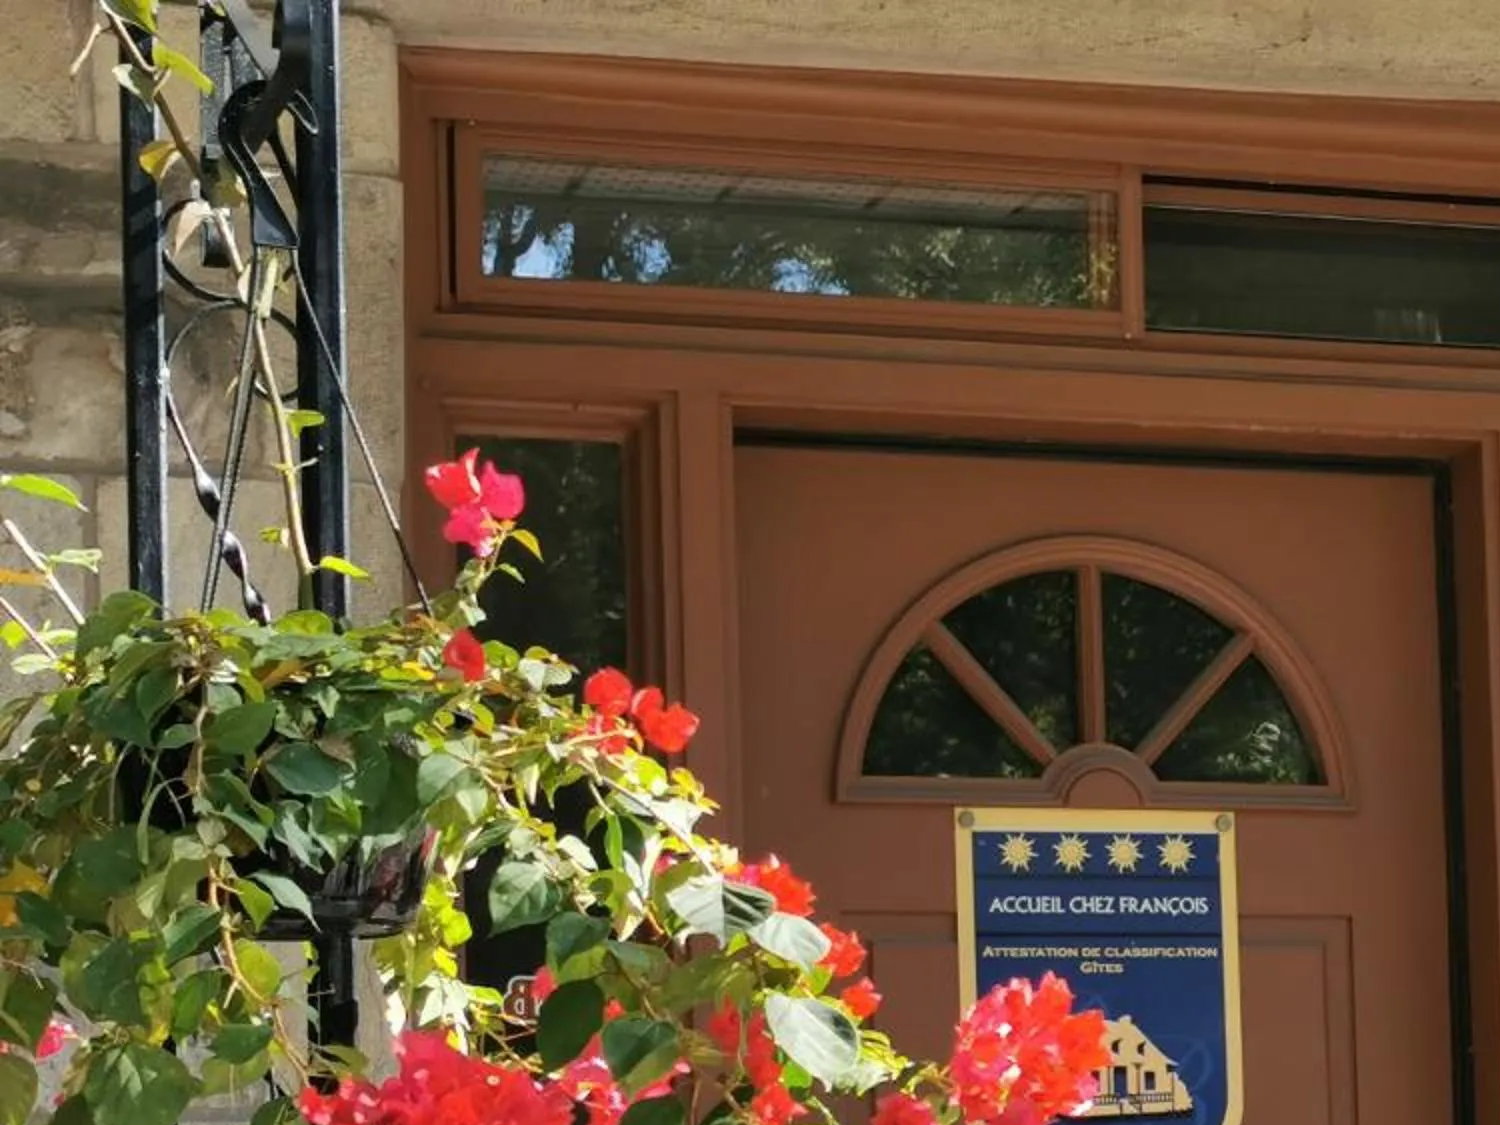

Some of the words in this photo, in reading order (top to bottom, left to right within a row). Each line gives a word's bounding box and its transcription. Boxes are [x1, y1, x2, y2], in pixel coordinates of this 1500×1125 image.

[989, 896, 1065, 914] ACCUEIL
[1069, 896, 1115, 914] CHEZ
[1119, 896, 1209, 917] FRANÇOIS
[982, 945, 1078, 958] ATTESTATION
[1082, 947, 1101, 958] DE
[1104, 946, 1218, 958] CLASSIFICATION
